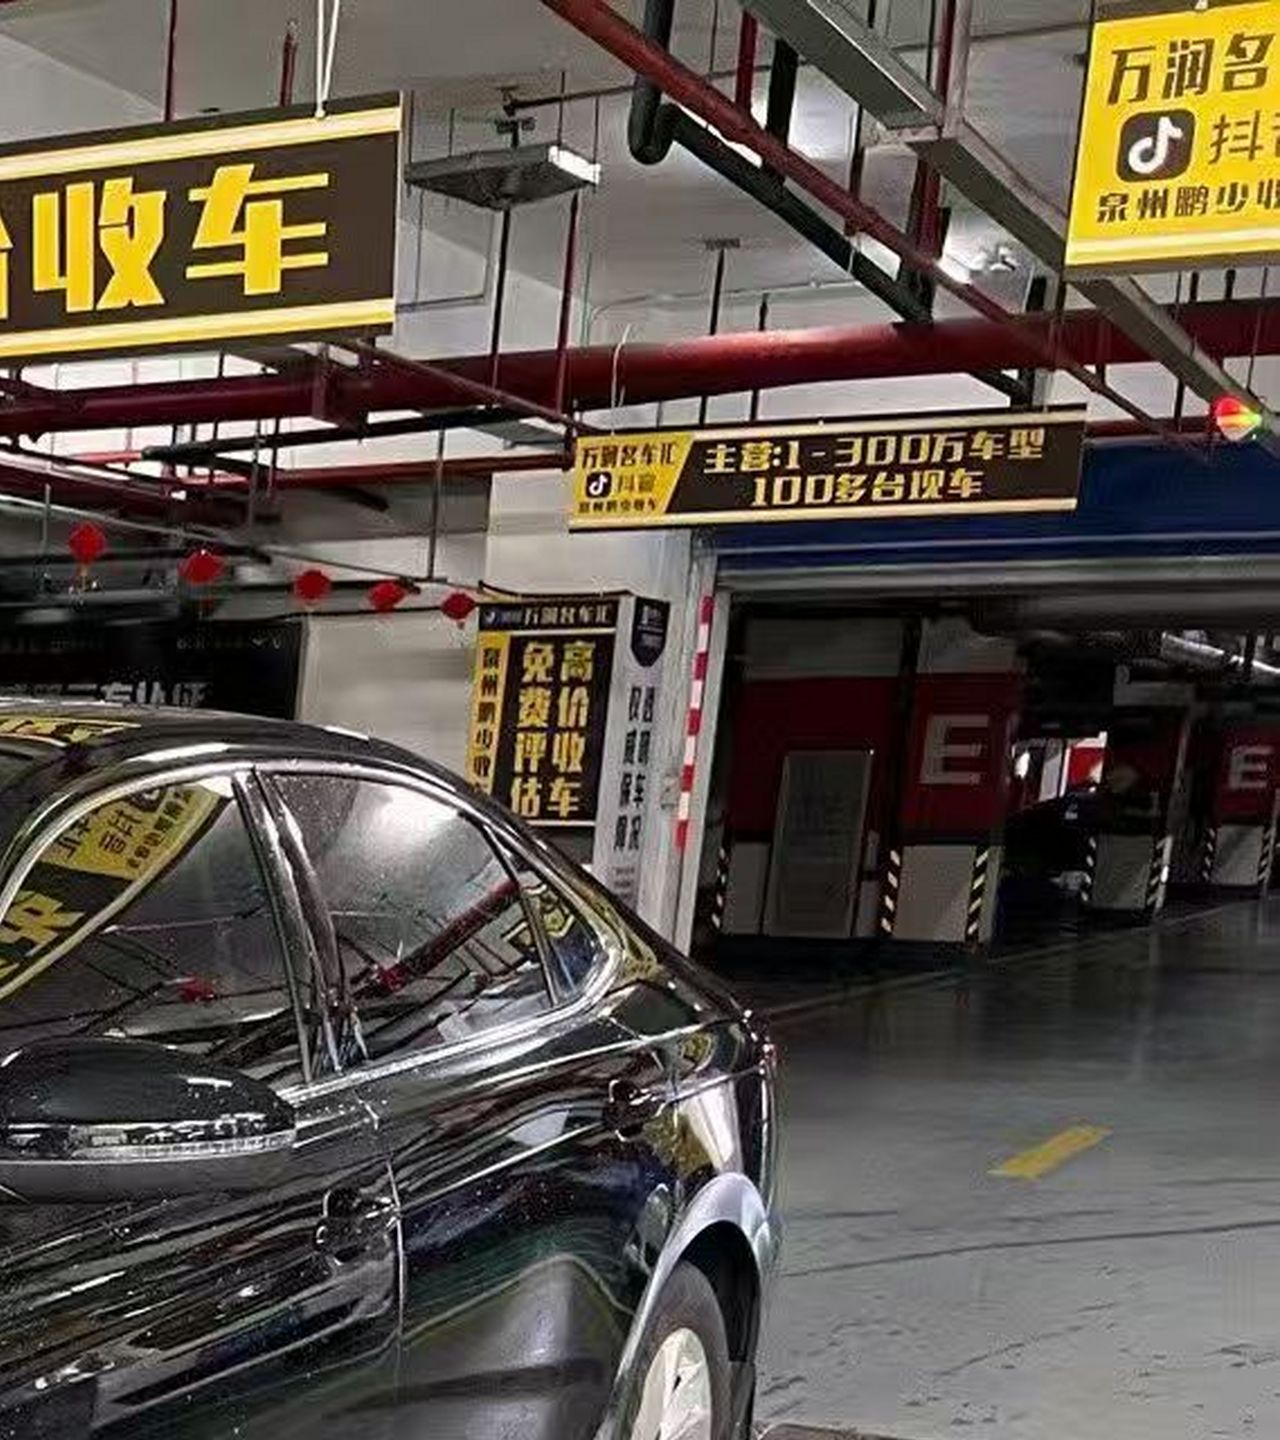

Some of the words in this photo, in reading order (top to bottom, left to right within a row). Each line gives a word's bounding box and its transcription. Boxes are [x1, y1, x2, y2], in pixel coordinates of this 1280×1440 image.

[1208, 110, 1280, 164] 抖
[546, 640, 596, 818] 高价收车
[920, 713, 990, 784] E
[1227, 744, 1274, 789] E
